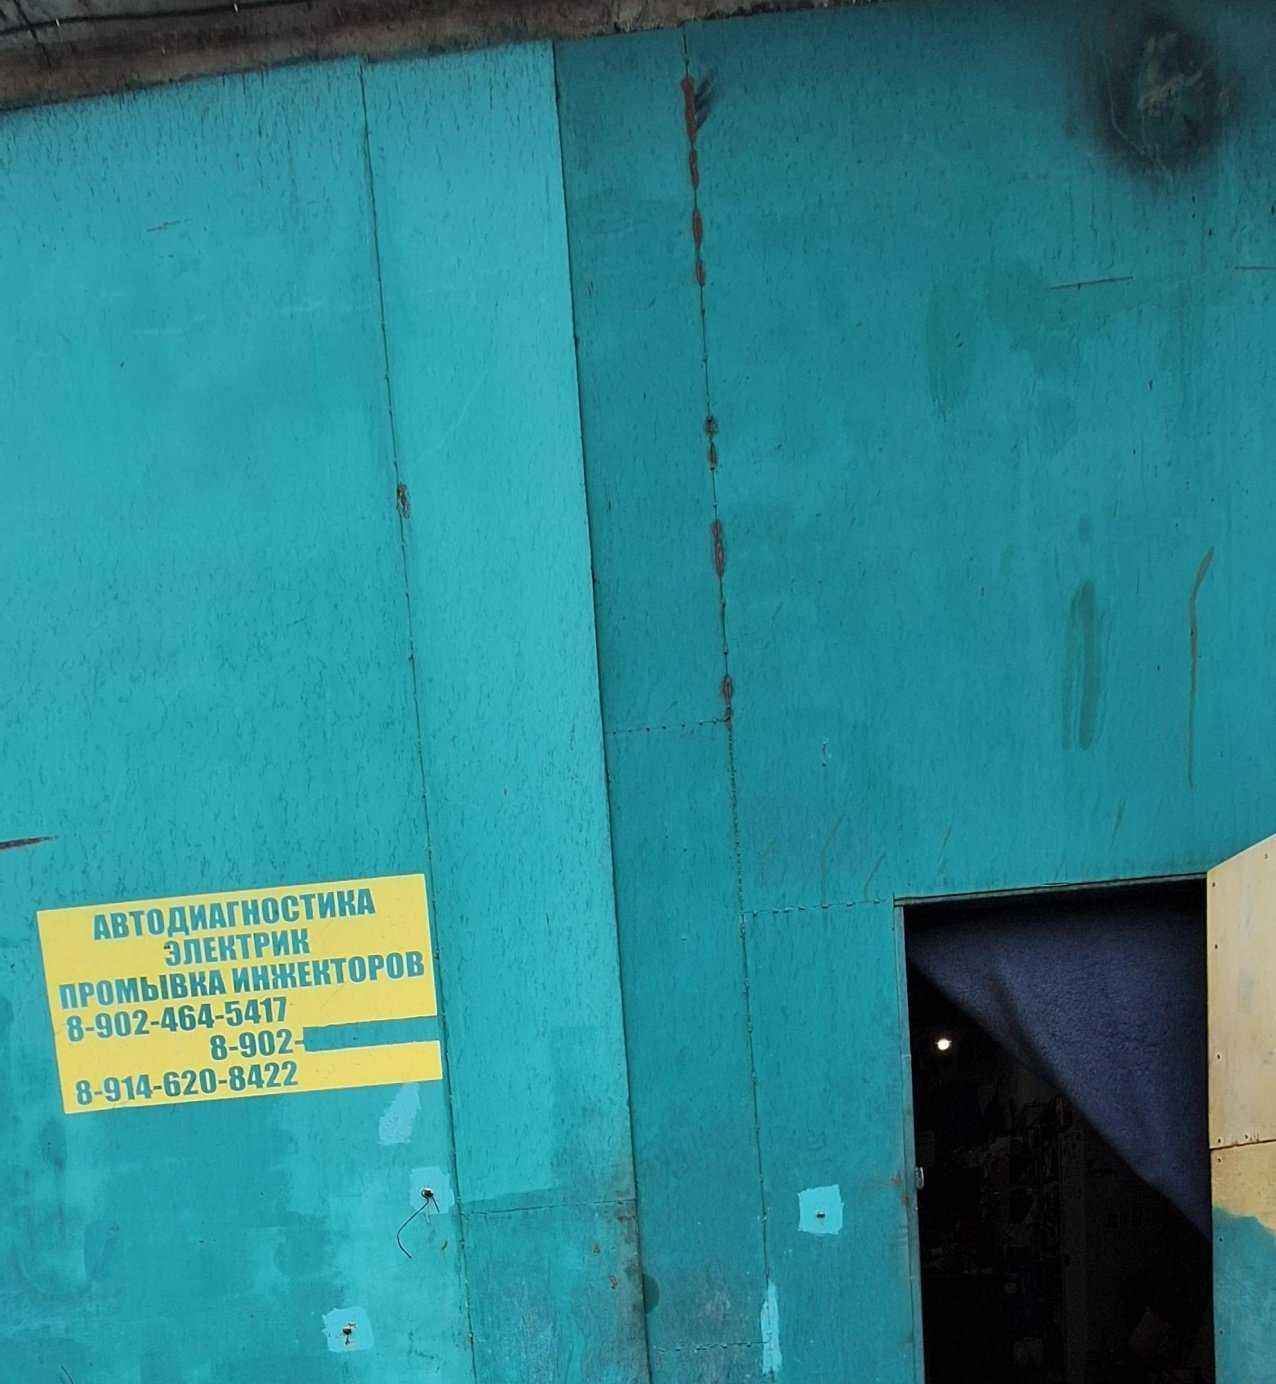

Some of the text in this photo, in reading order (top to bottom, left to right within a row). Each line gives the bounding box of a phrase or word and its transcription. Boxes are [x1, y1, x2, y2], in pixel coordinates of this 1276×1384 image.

[93, 888, 376, 940] АВТОДИАГНОСТИКА
[164, 928, 311, 967] ЭЛЕКТРИК
[59, 951, 424, 1010] ПРОМЫВКА ИНЖЕКТОРОВ
[66, 996, 288, 1042] 8-902-464-5417
[75, 1060, 299, 1106] 8-914-620-8422
